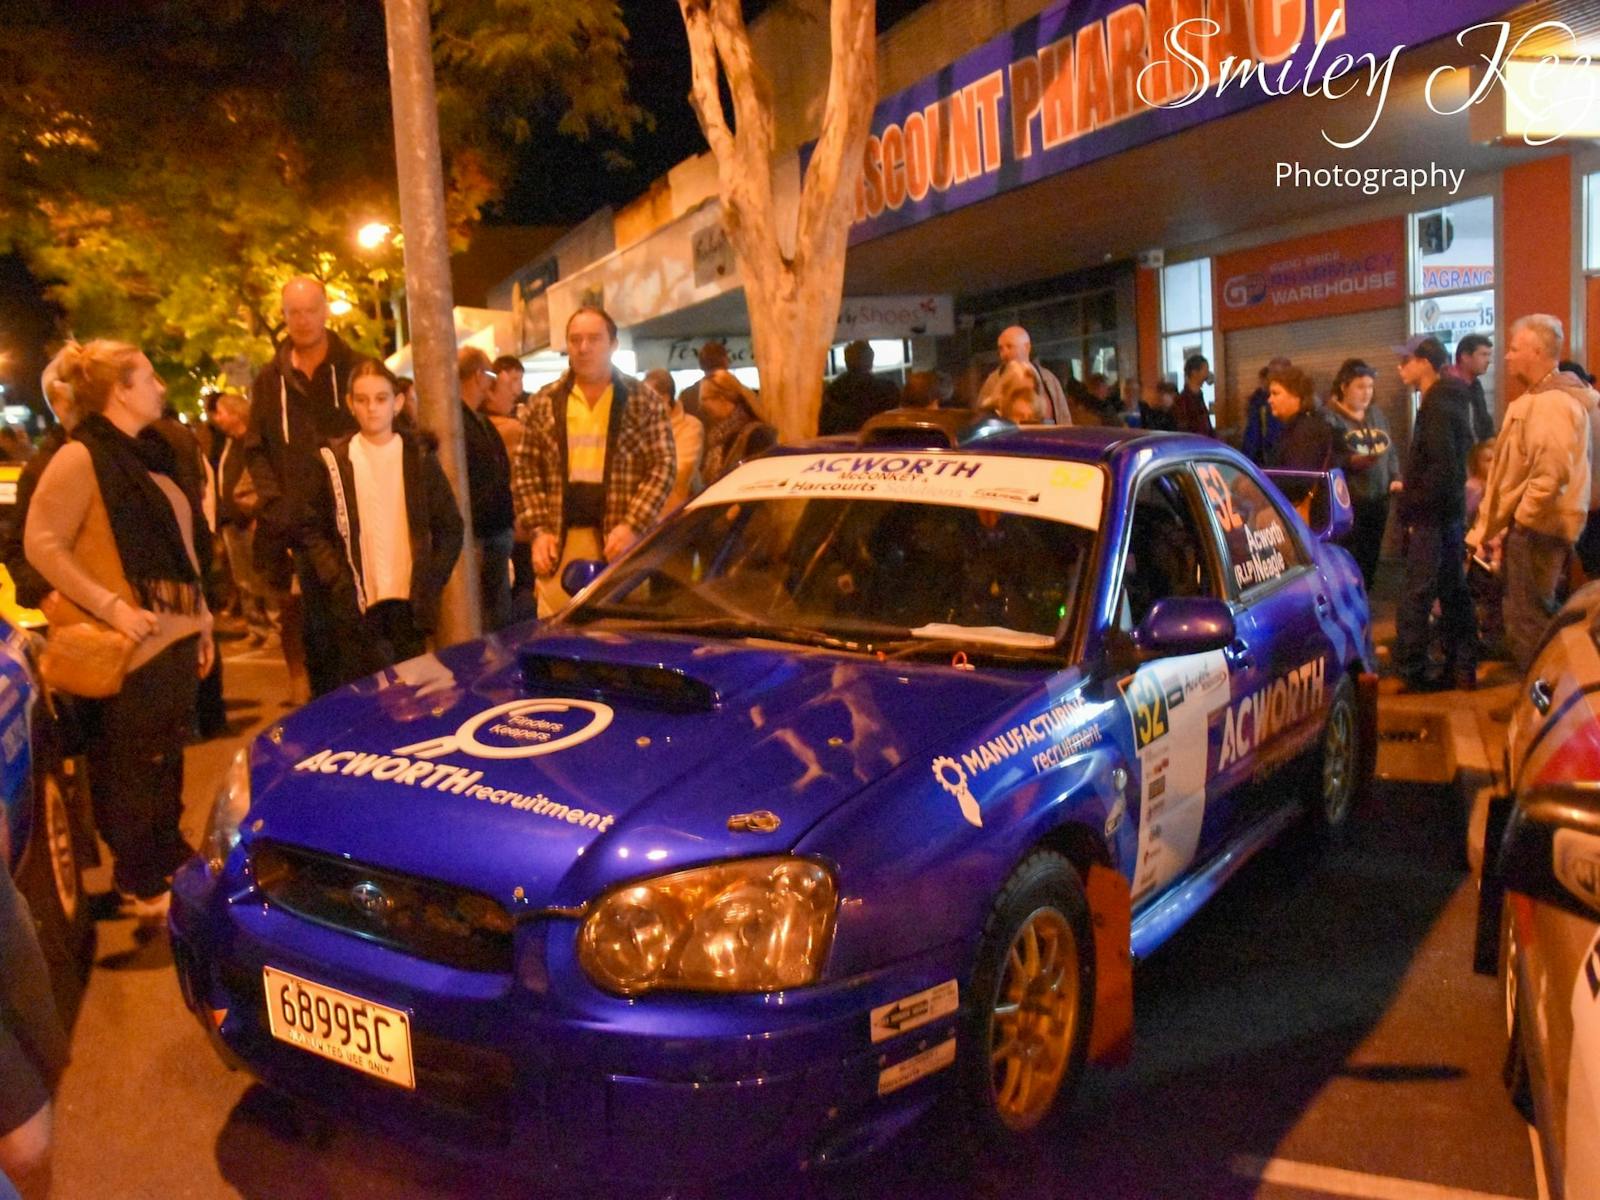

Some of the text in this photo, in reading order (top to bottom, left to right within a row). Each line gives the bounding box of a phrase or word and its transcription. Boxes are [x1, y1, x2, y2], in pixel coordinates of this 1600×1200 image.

[855, 69, 1003, 223] SCOUNT
[1271, 271, 1397, 305] WAREHOUSE
[802, 457, 982, 479] ACWORTH
[1050, 464, 1096, 492] 52
[791, 480, 877, 493] Harcourts
[1196, 464, 1244, 532] 52
[1243, 520, 1286, 553] Acworth
[1131, 672, 1166, 745] 52
[1218, 655, 1325, 772] ACWORTH
[488, 724, 551, 743] Keepers
[1032, 723, 1103, 775] recruitment
[281, 984, 394, 1062] 68995C
[368, 1060, 392, 1076] ONLY
